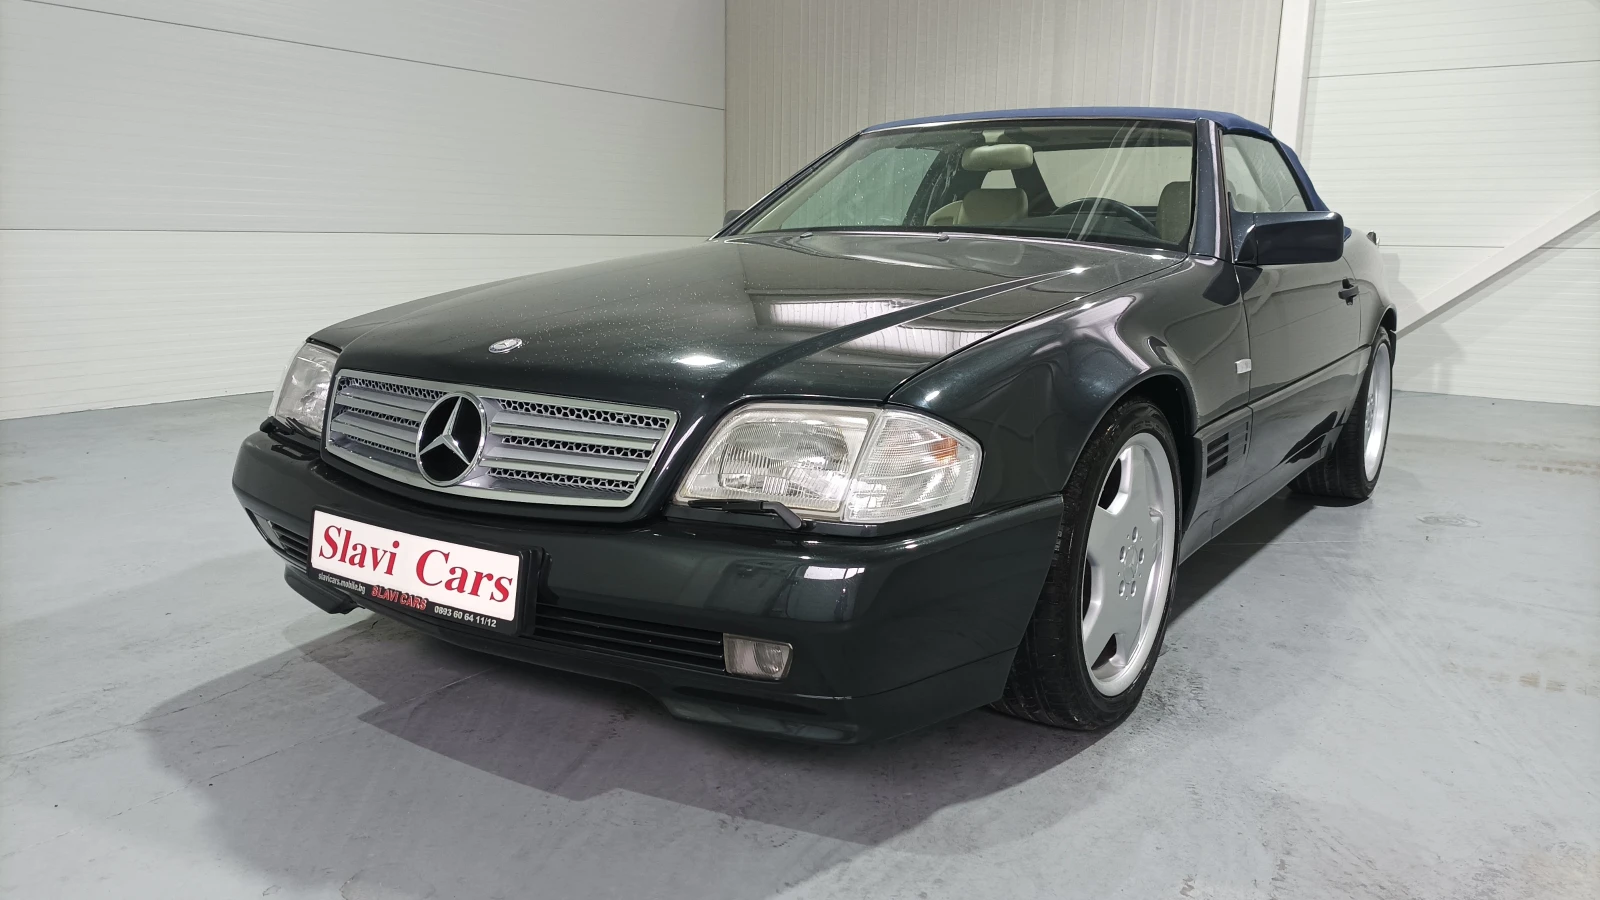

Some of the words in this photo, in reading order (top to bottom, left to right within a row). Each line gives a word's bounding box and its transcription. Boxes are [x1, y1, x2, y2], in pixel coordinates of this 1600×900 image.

[319, 525, 400, 576] Slavi
[416, 549, 513, 603] Cars
[318, 572, 366, 595] slavicars.mobile.bg
[371, 585, 399, 603] SLAVI
[400, 594, 428, 611] CARS
[434, 605, 452, 617] 0893
[453, 610, 463, 620] 60
[464, 613, 474, 622] 64
[475, 615, 497, 628] 11/12
